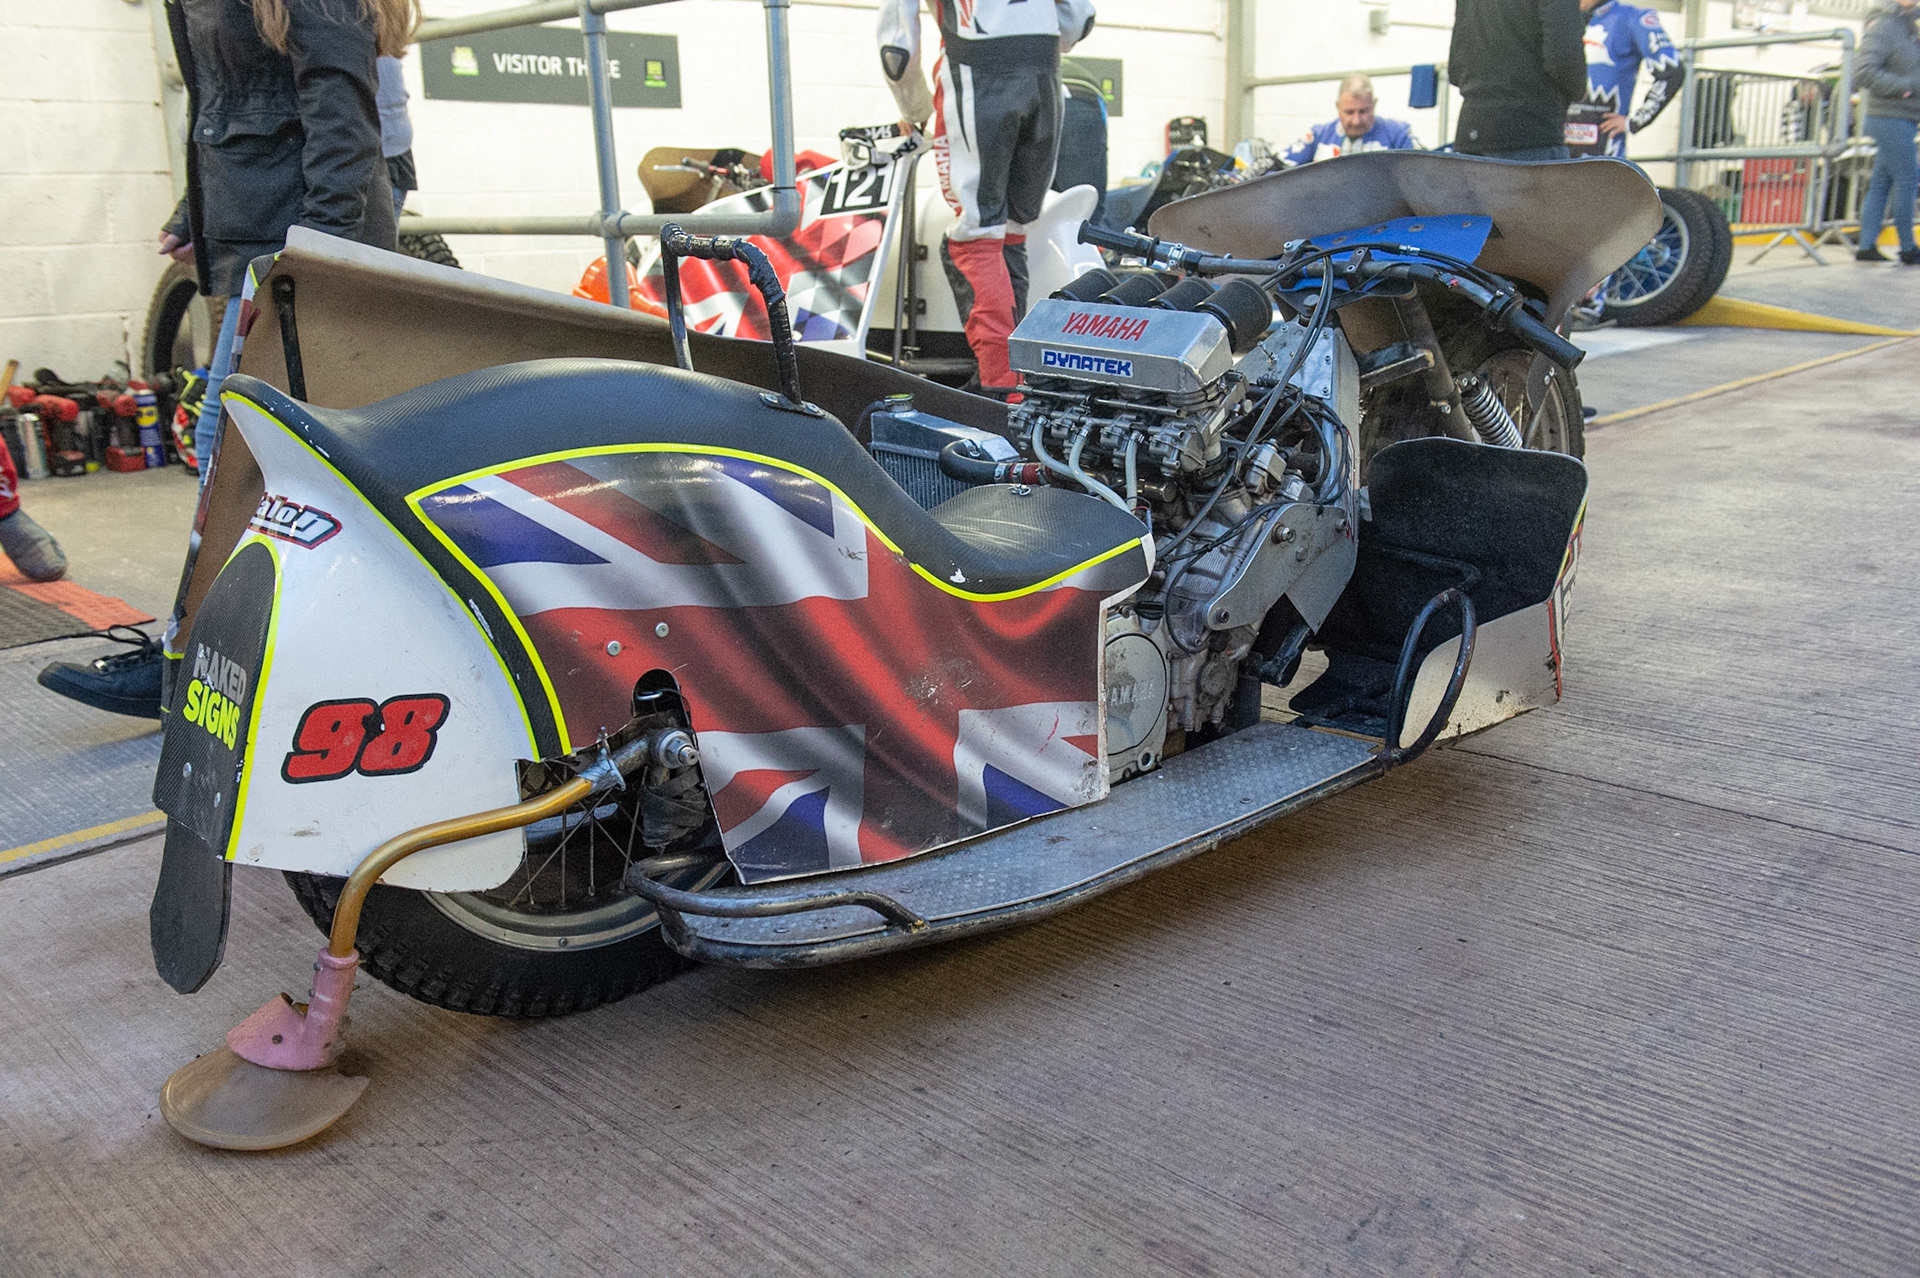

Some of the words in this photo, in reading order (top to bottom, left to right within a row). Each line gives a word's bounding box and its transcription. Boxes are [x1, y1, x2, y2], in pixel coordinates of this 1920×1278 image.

[492, 52, 562, 76] VISITOR
[831, 160, 897, 210] 121
[1061, 312, 1149, 342] YAMAHA
[1043, 351, 1131, 377] DYNATEK
[192, 642, 247, 706] NAKED
[183, 679, 240, 751] SIGNS
[281, 693, 451, 784] 98
